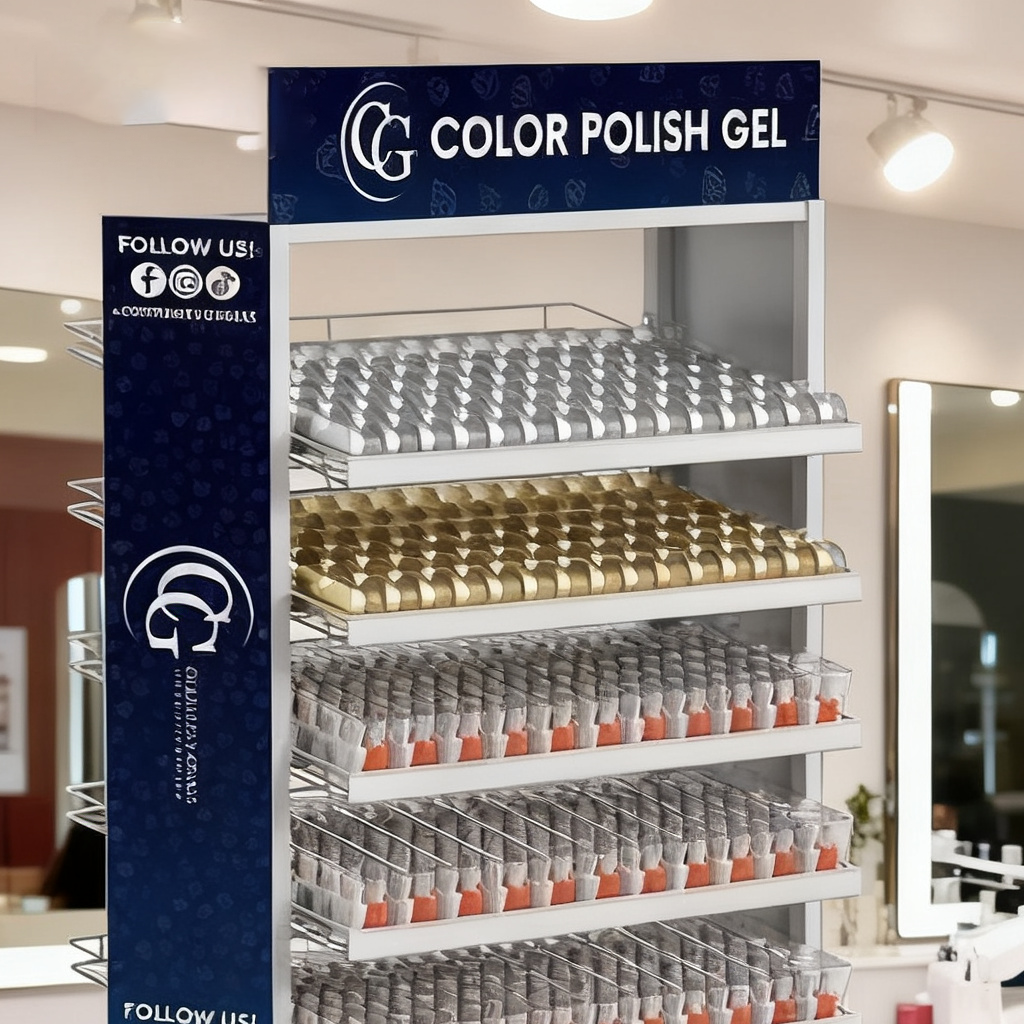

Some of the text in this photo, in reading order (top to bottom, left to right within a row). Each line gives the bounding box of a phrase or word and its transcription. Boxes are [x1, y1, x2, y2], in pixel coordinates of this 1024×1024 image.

[430, 107, 787, 160] COLOR POLISH GEL
[117, 235, 254, 258] FOLLOW US!
